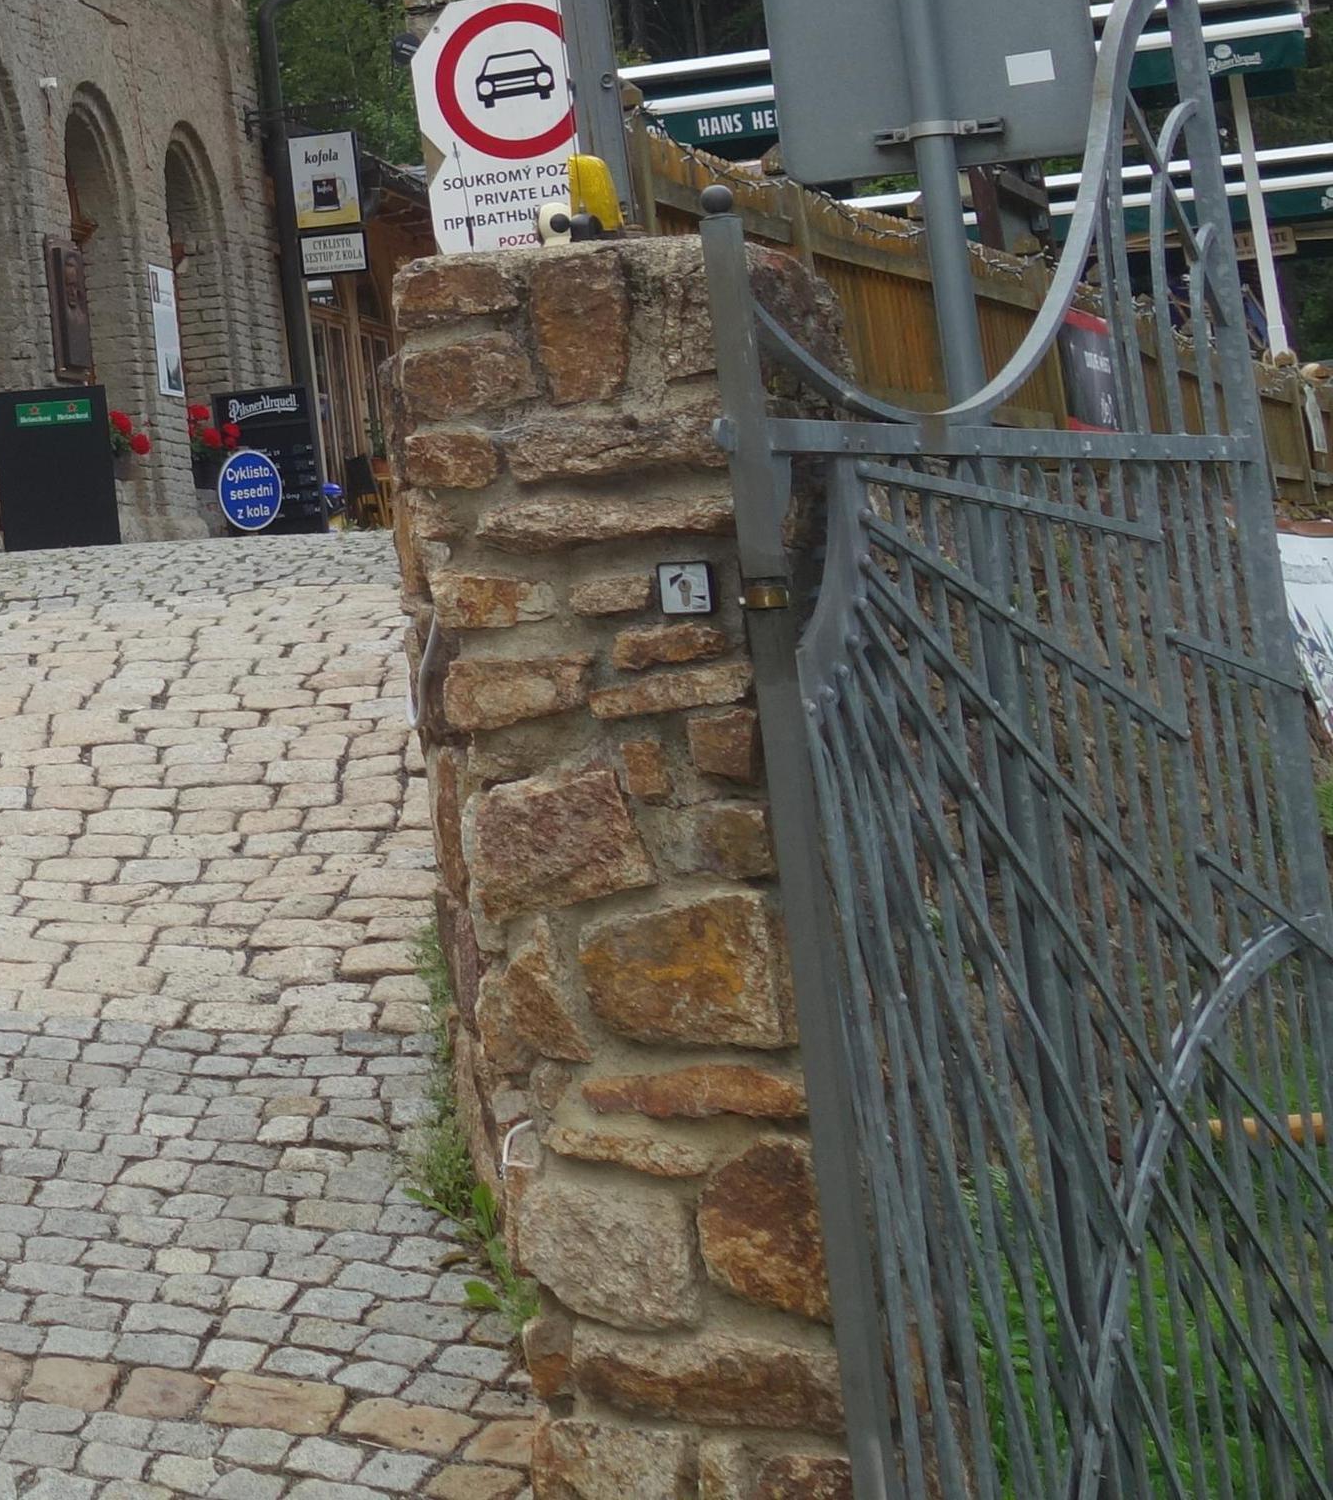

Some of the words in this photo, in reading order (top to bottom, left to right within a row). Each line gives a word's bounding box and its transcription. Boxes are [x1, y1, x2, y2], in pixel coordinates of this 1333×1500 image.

[698, 113, 743, 137] HANS
[304, 148, 339, 166] kofola
[443, 165, 531, 191] SOUKROMÝ
[536, 163, 568, 178] POZ
[475, 187, 537, 206] PRIVATE
[541, 183, 571, 198] LAN
[499, 233, 537, 247] POZO
[335, 250, 341, 261] Z
[342, 248, 363, 260] KOLA
[228, 398, 262, 424] Pilsner
[260, 393, 297, 414] Urquell
[237, 508, 244, 519] z
[246, 504, 270, 518] kola
